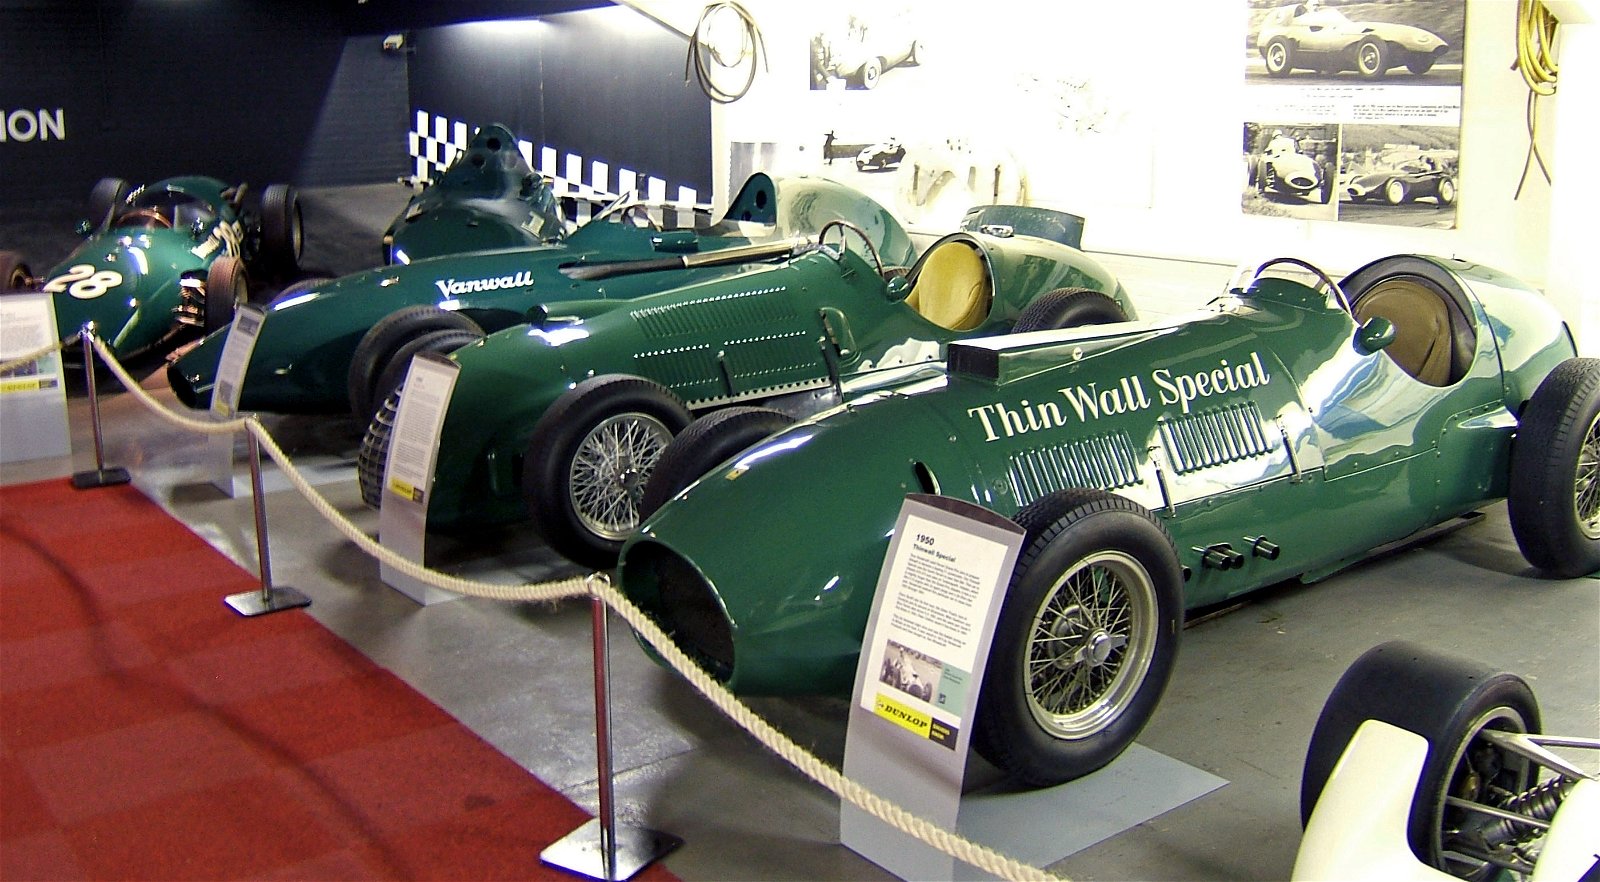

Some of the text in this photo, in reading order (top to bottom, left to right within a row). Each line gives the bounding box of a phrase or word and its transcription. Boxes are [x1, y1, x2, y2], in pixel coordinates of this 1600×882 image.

[42, 264, 123, 300] 28
[435, 271, 534, 300] Vanwall
[967, 352, 1270, 443] Thin Wall Special
[916, 533, 935, 546] 1950
[936, 551, 957, 563] Special
[885, 704, 928, 729] DUNLOP
